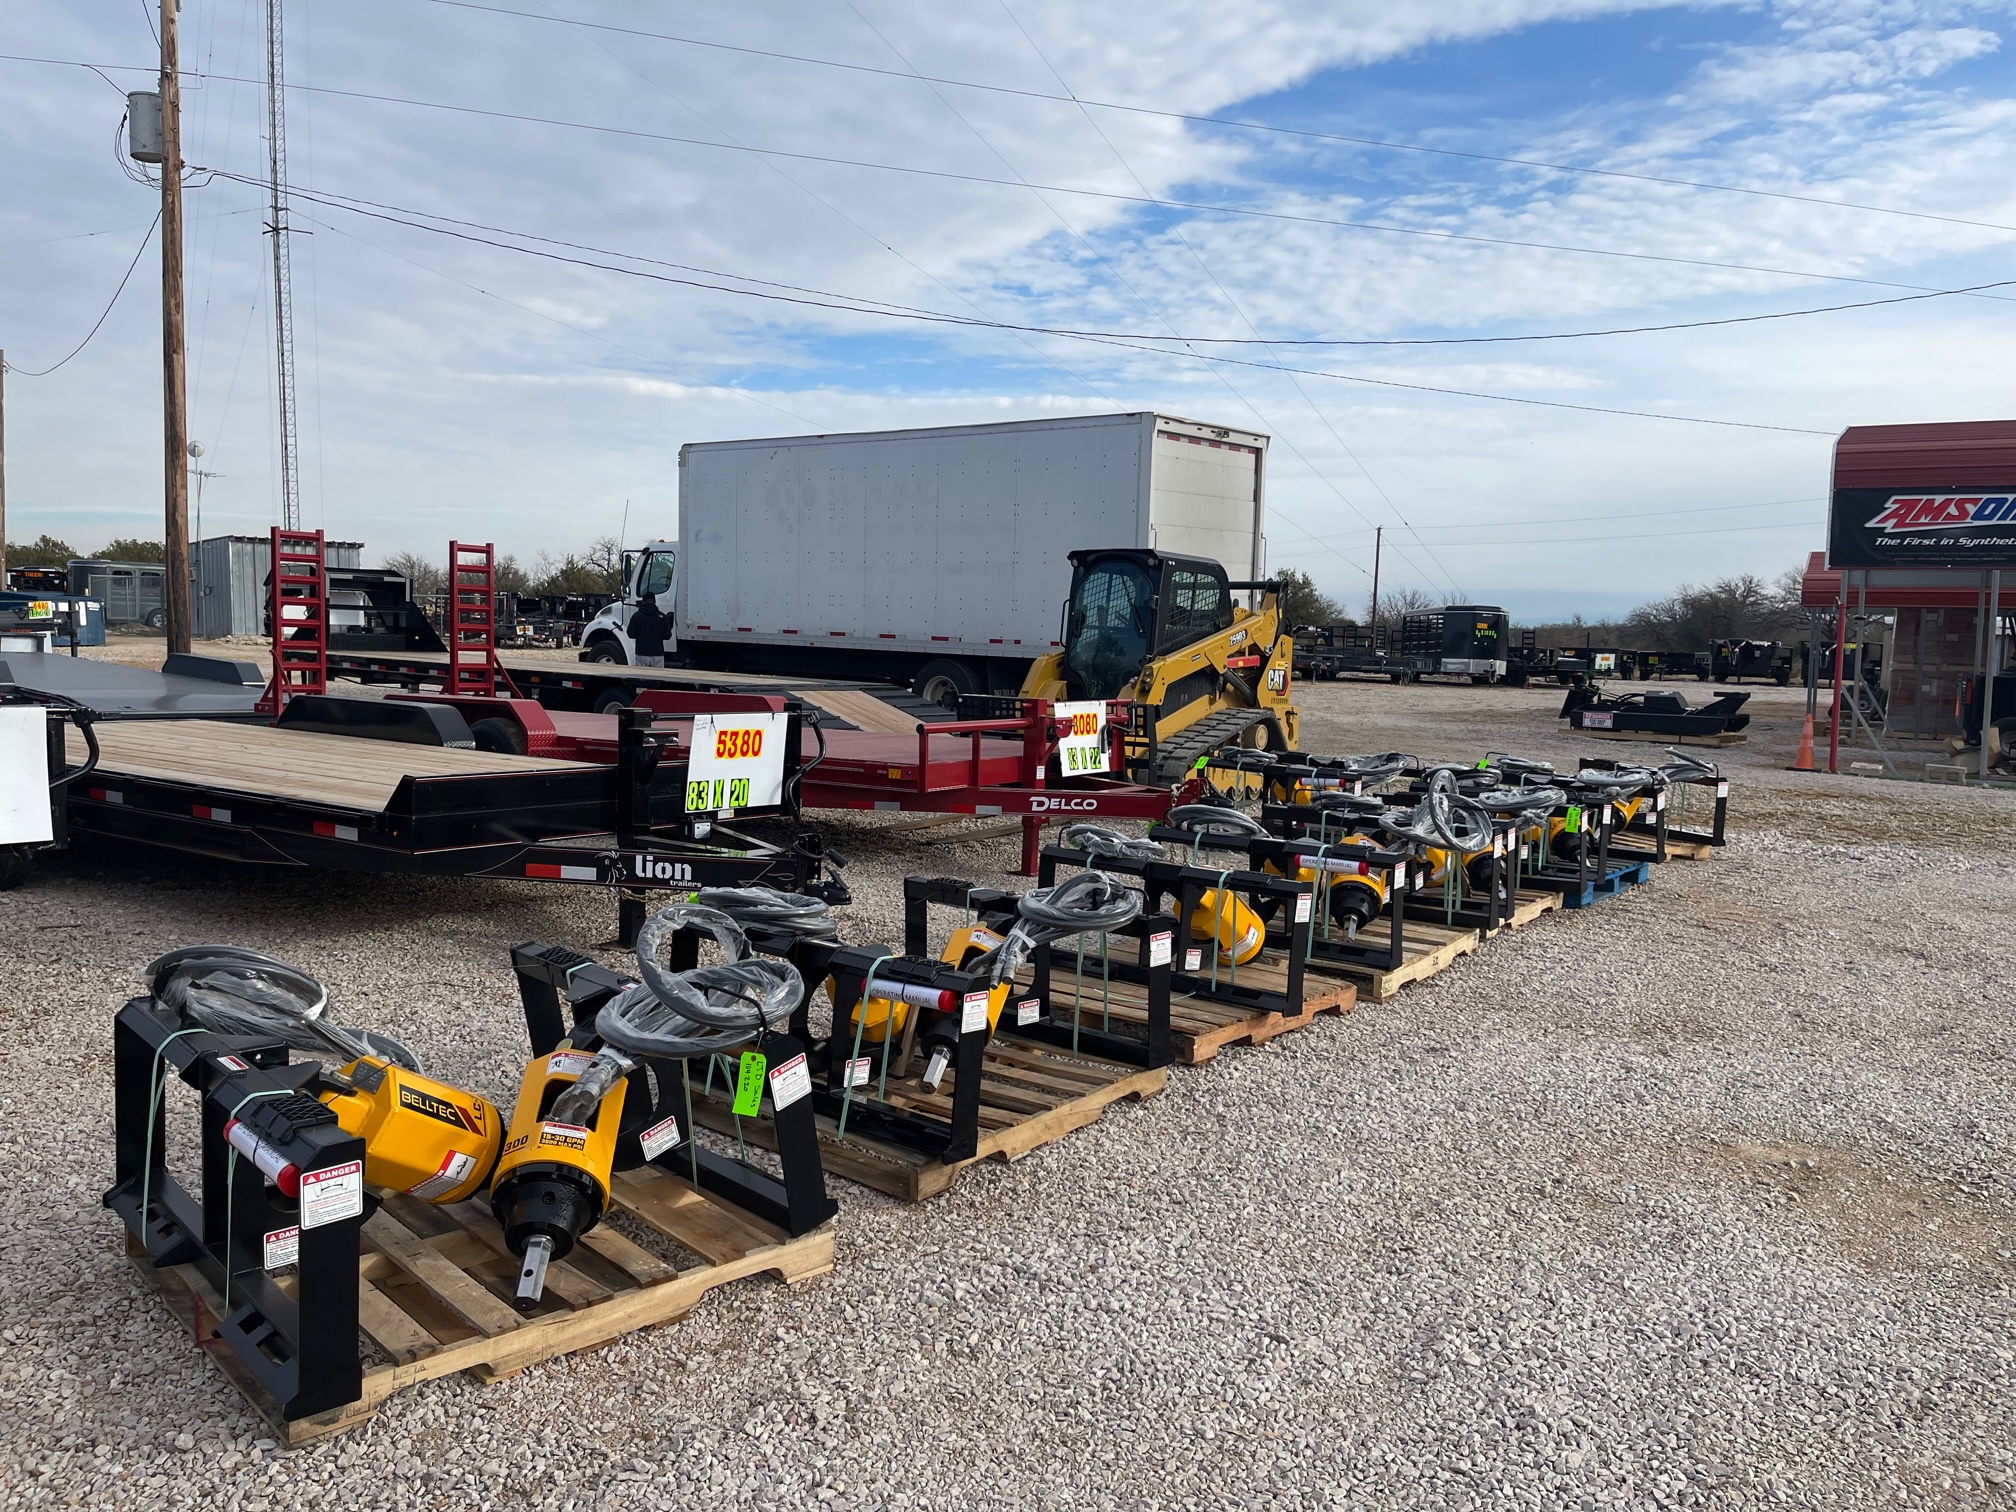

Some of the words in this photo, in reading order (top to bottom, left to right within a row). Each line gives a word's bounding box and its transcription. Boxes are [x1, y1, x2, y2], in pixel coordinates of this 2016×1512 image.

[1875, 537, 1901, 546] The
[1903, 537, 1937, 546] First
[1940, 537, 1954, 546] in
[1268, 669, 1285, 690] CAT
[716, 730, 763, 758] 5380
[1067, 749, 1078, 769] 83
[1080, 747, 1088, 769] X
[1090, 747, 1101, 769] 22
[687, 781, 708, 811] 83
[713, 780, 724, 807] X
[730, 778, 749, 807] 20
[1029, 796, 1098, 811] DELCO
[635, 855, 692, 880] lion
[1330, 861, 1353, 869] MANUAL
[905, 994, 933, 1005] MANUAL
[780, 1057, 803, 1073] DANGER
[401, 1091, 456, 1121] BELLTEC
[649, 1119, 672, 1136] DANGER
[504, 1134, 529, 1152] 300
[566, 1137, 585, 1146] GPM
[319, 1165, 357, 1180] DANGER
